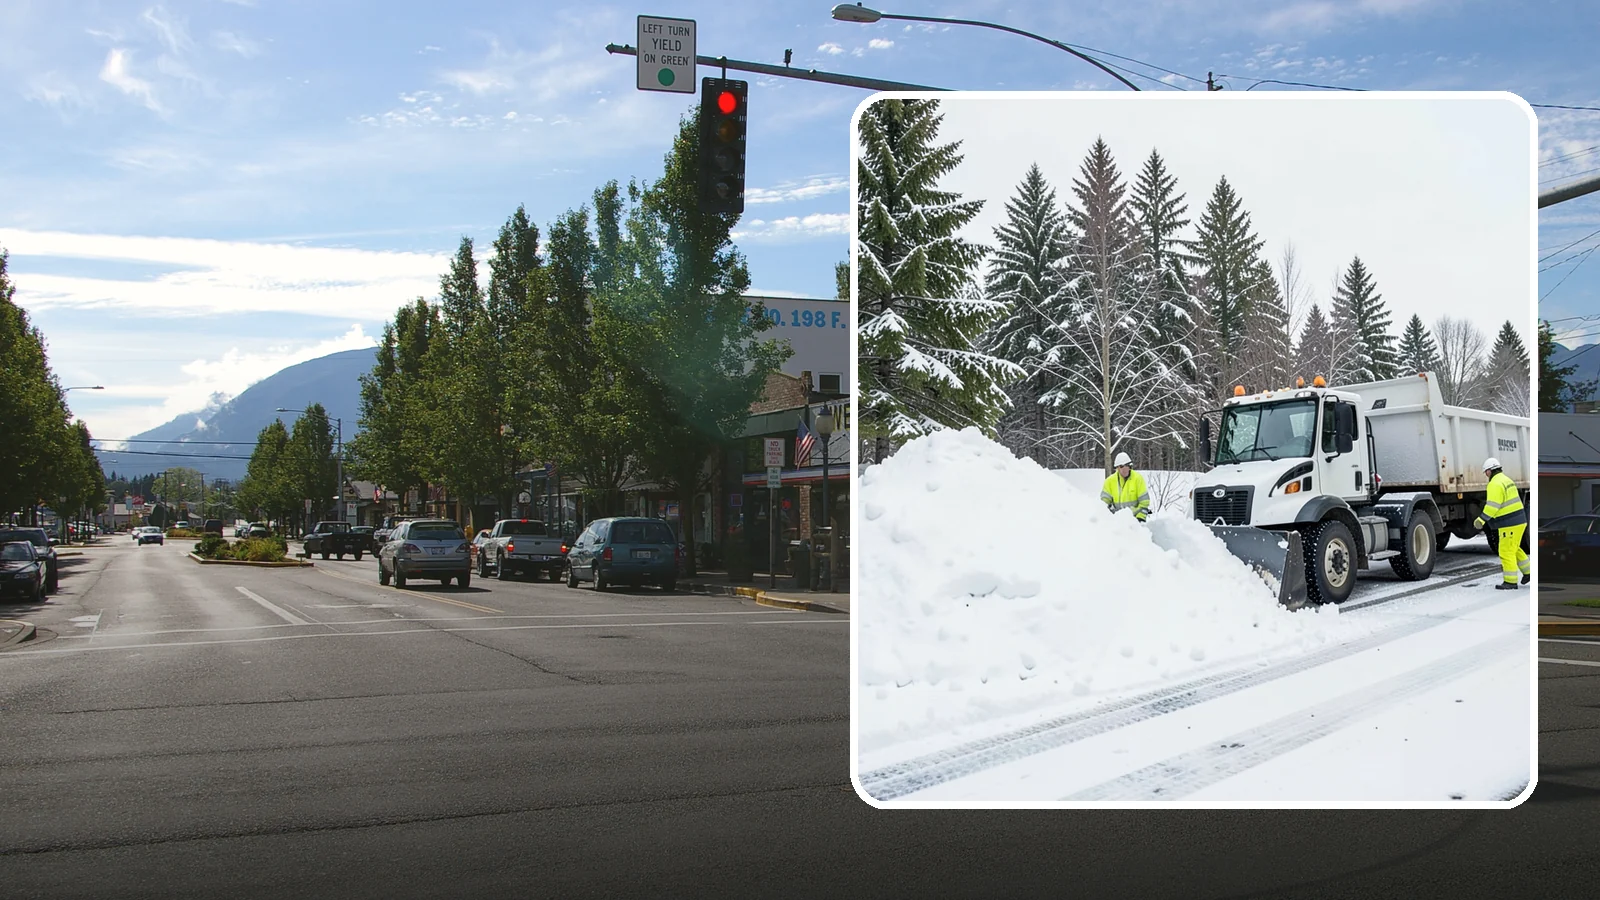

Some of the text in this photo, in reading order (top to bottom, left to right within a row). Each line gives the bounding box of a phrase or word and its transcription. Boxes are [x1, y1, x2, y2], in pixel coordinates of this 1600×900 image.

[642, 23, 690, 37] LEFT TURN
[652, 37, 682, 52] YIELD
[644, 53, 689, 66] ON GREEN
[791, 309, 826, 329] 198
[831, 311, 847, 329] F.
